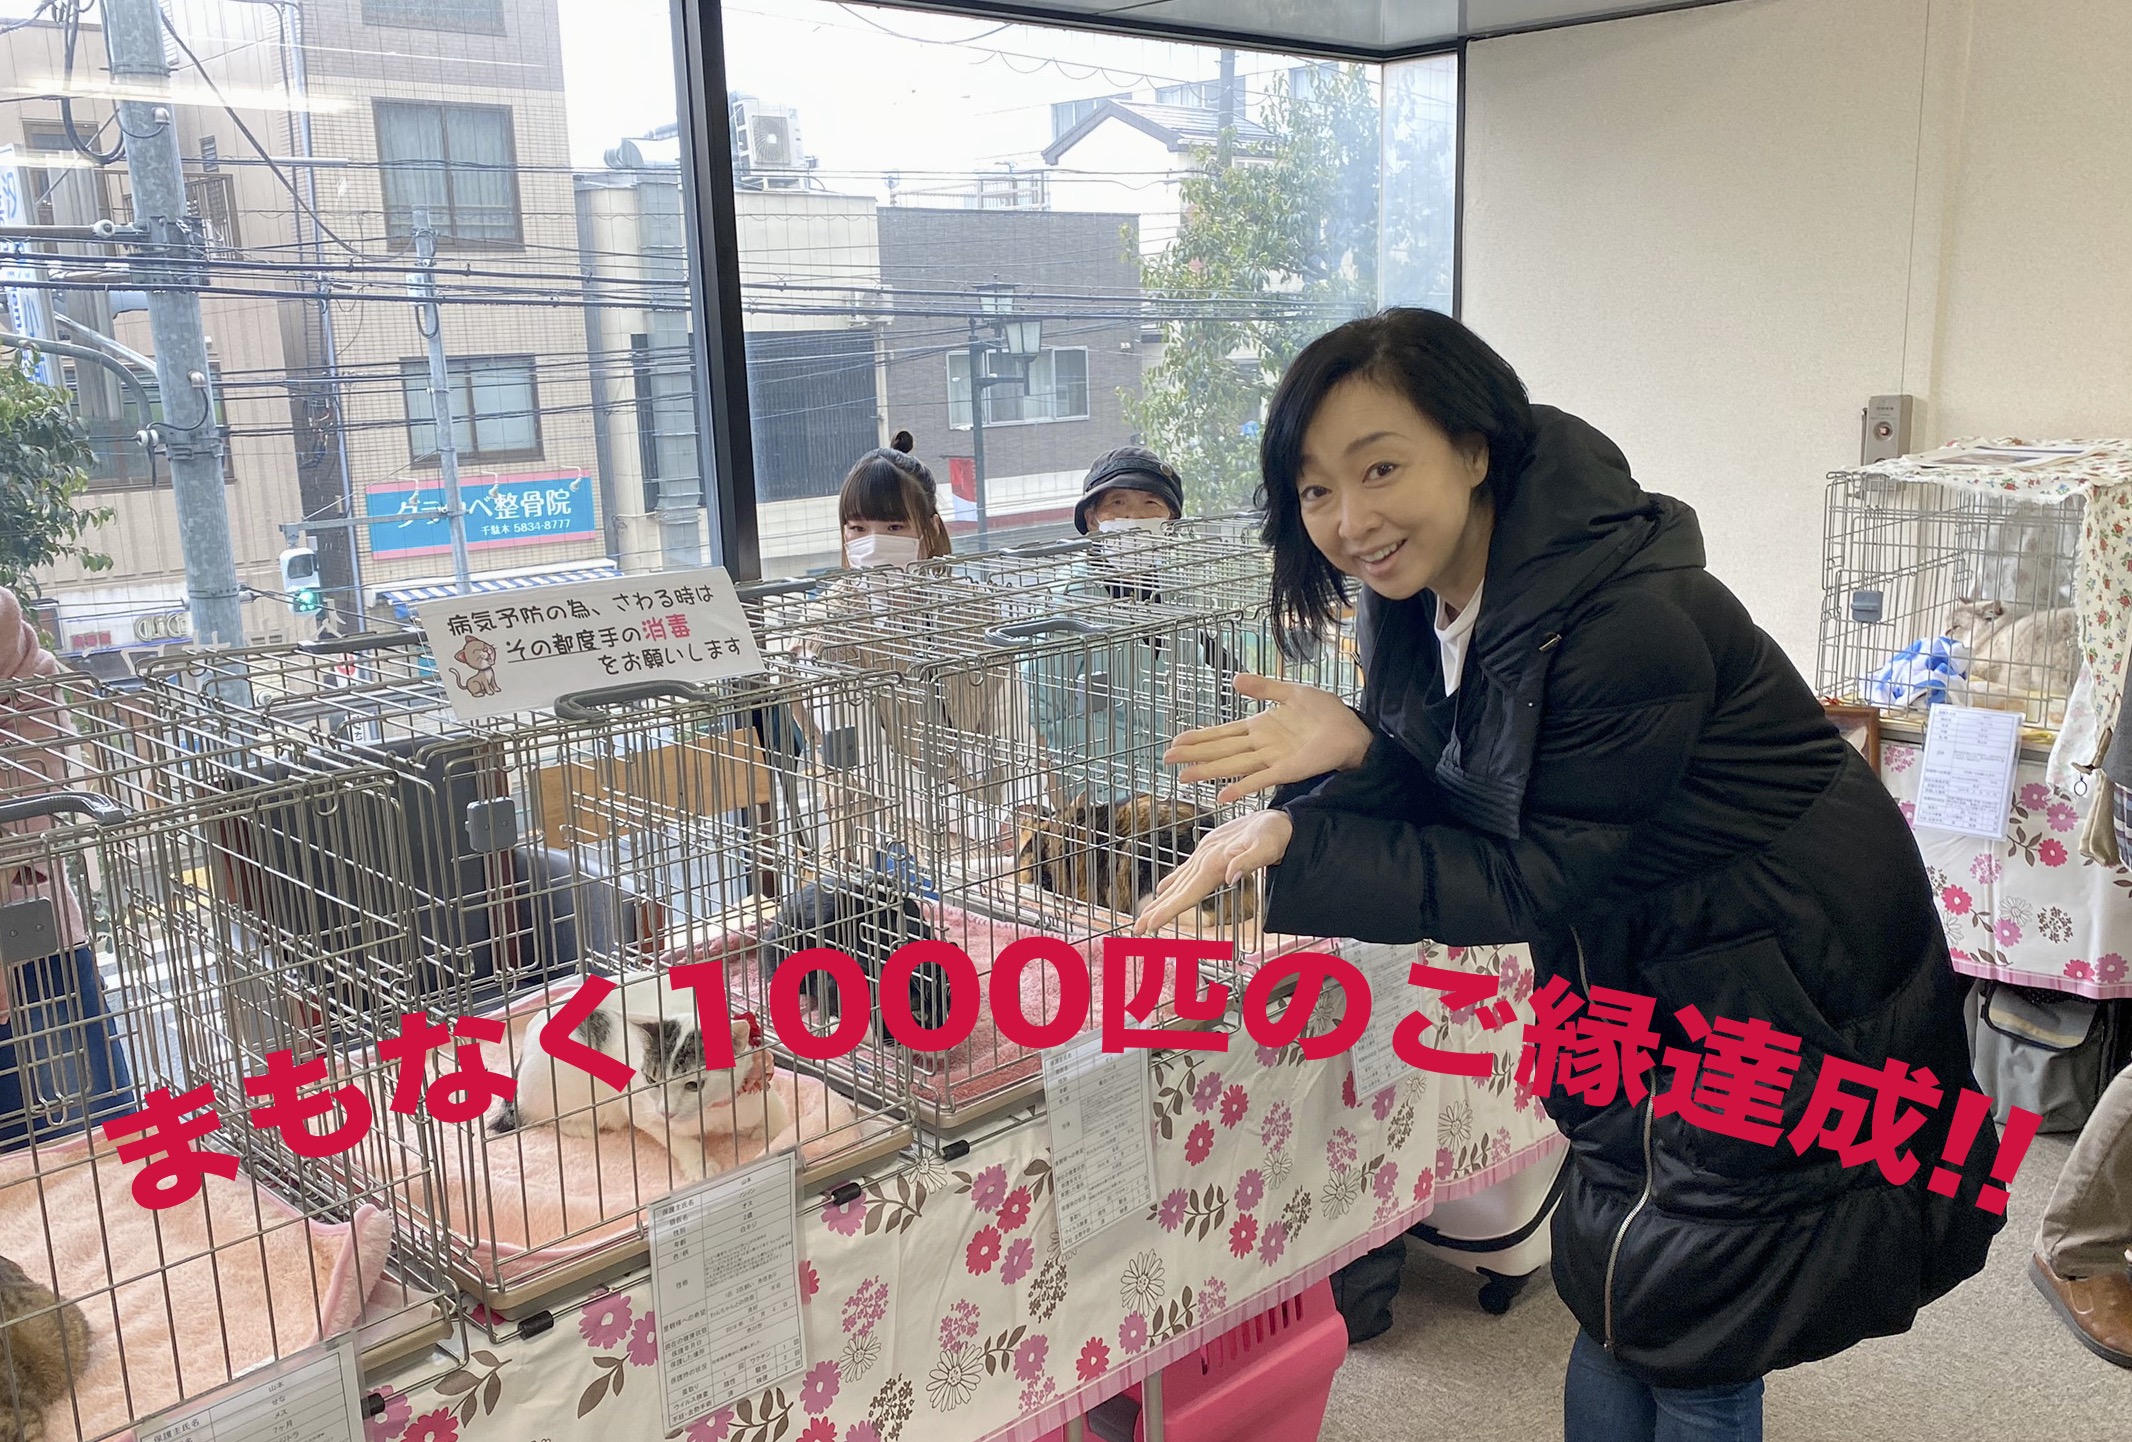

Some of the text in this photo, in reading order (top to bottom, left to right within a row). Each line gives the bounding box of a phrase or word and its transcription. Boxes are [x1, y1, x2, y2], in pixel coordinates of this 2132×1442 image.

[398, 488, 572, 528] グラベ整骨院
[481, 519, 571, 536] 千駄木 5834-8777
[447, 584, 715, 637] 病気予防の為、さわる時は
[505, 613, 691, 660] その都度手の消毒
[598, 636, 742, 676] をお願いします
